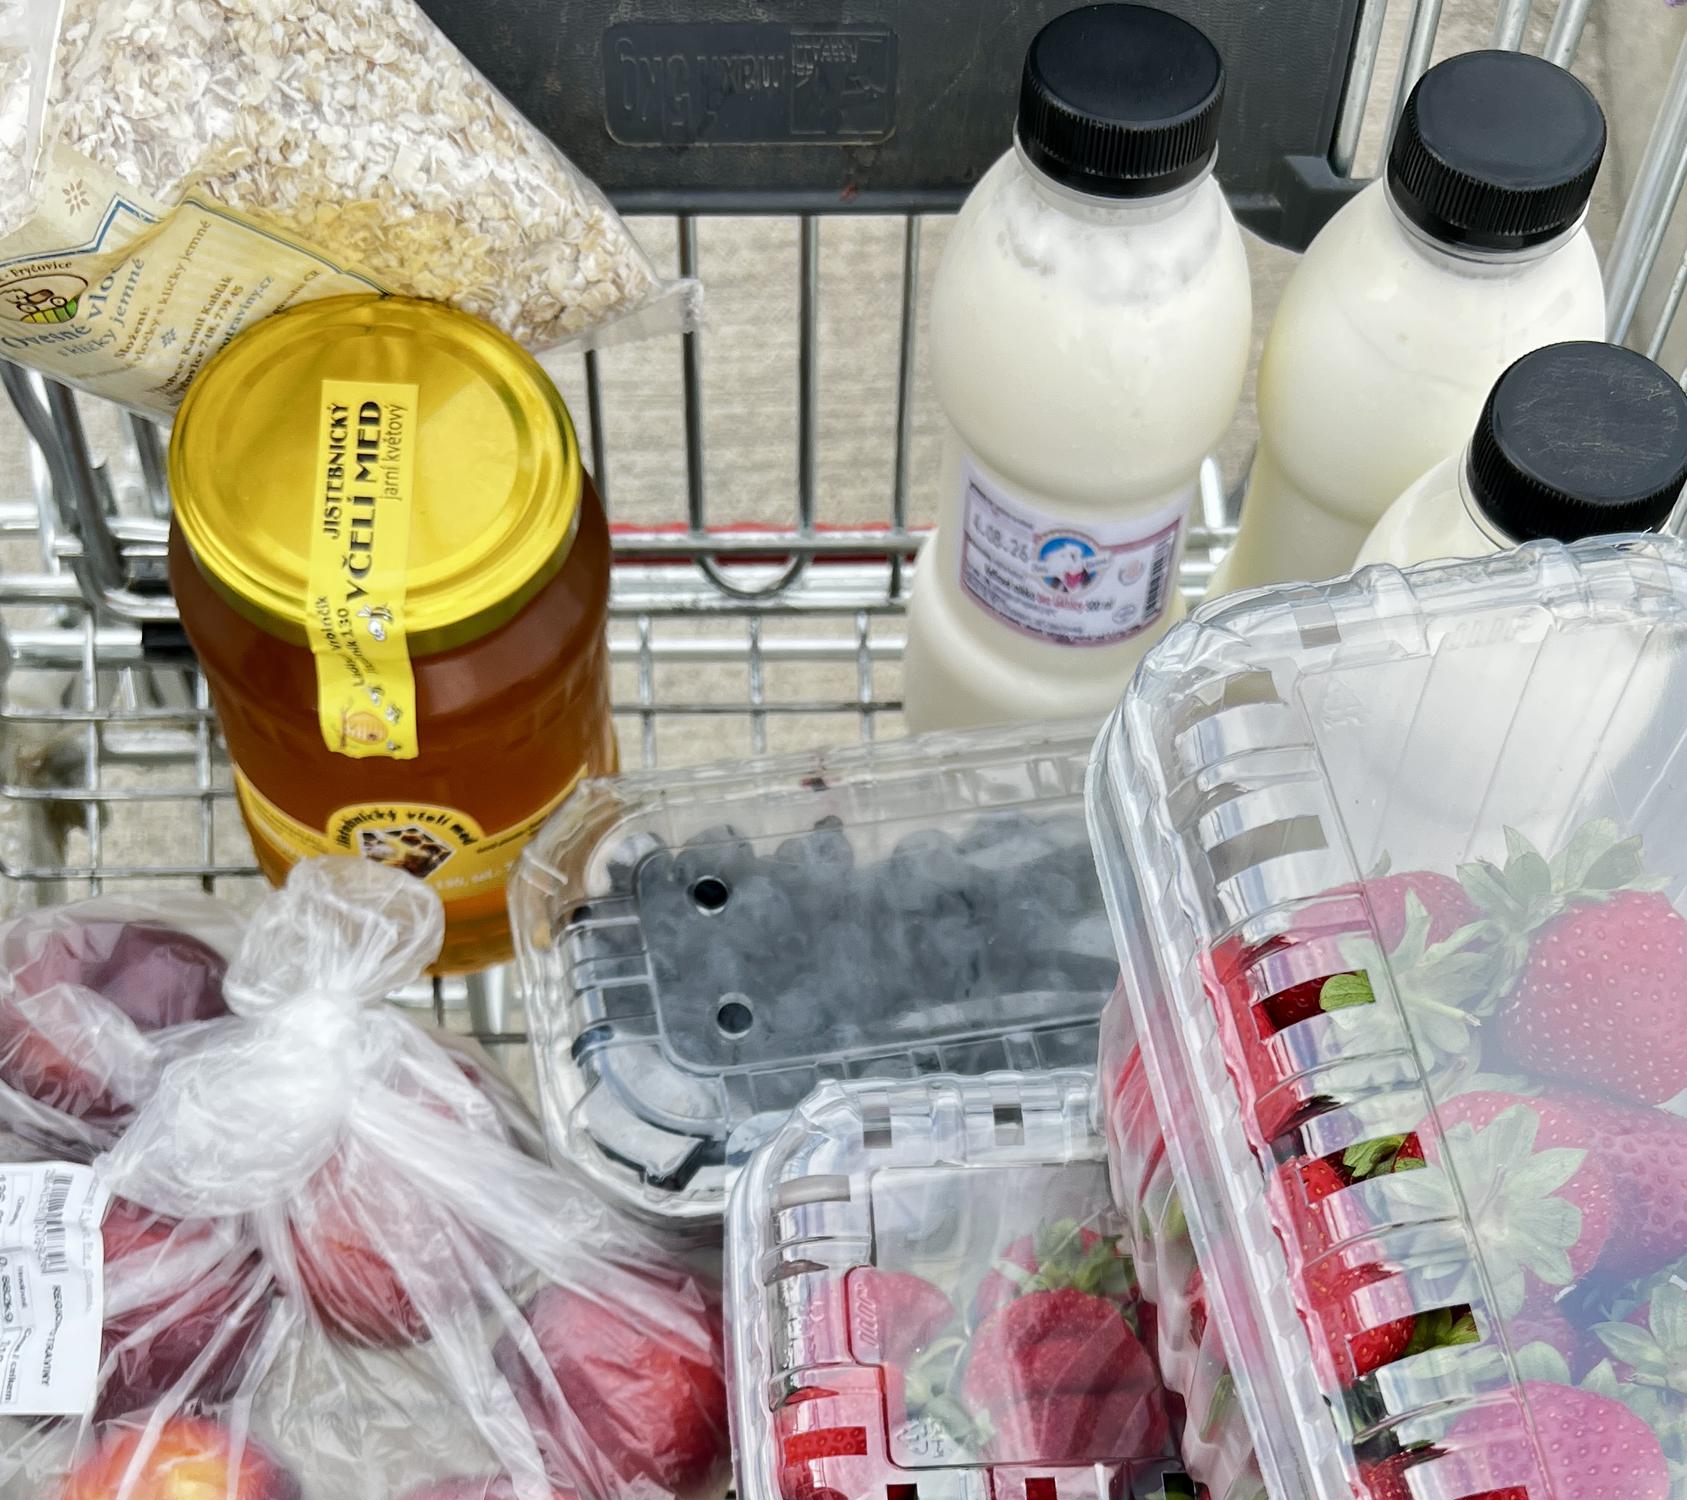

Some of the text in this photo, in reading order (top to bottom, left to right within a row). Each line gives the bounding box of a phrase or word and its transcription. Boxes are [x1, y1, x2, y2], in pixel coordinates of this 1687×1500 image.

[182, 220, 212, 263] jemné
[109, 258, 145, 328] jemné
[181, 316, 206, 356] Kamil
[322, 402, 349, 540] JISTEBNICKÝ
[379, 403, 408, 501] jarní květový
[341, 401, 382, 602] VČELÍ MED
